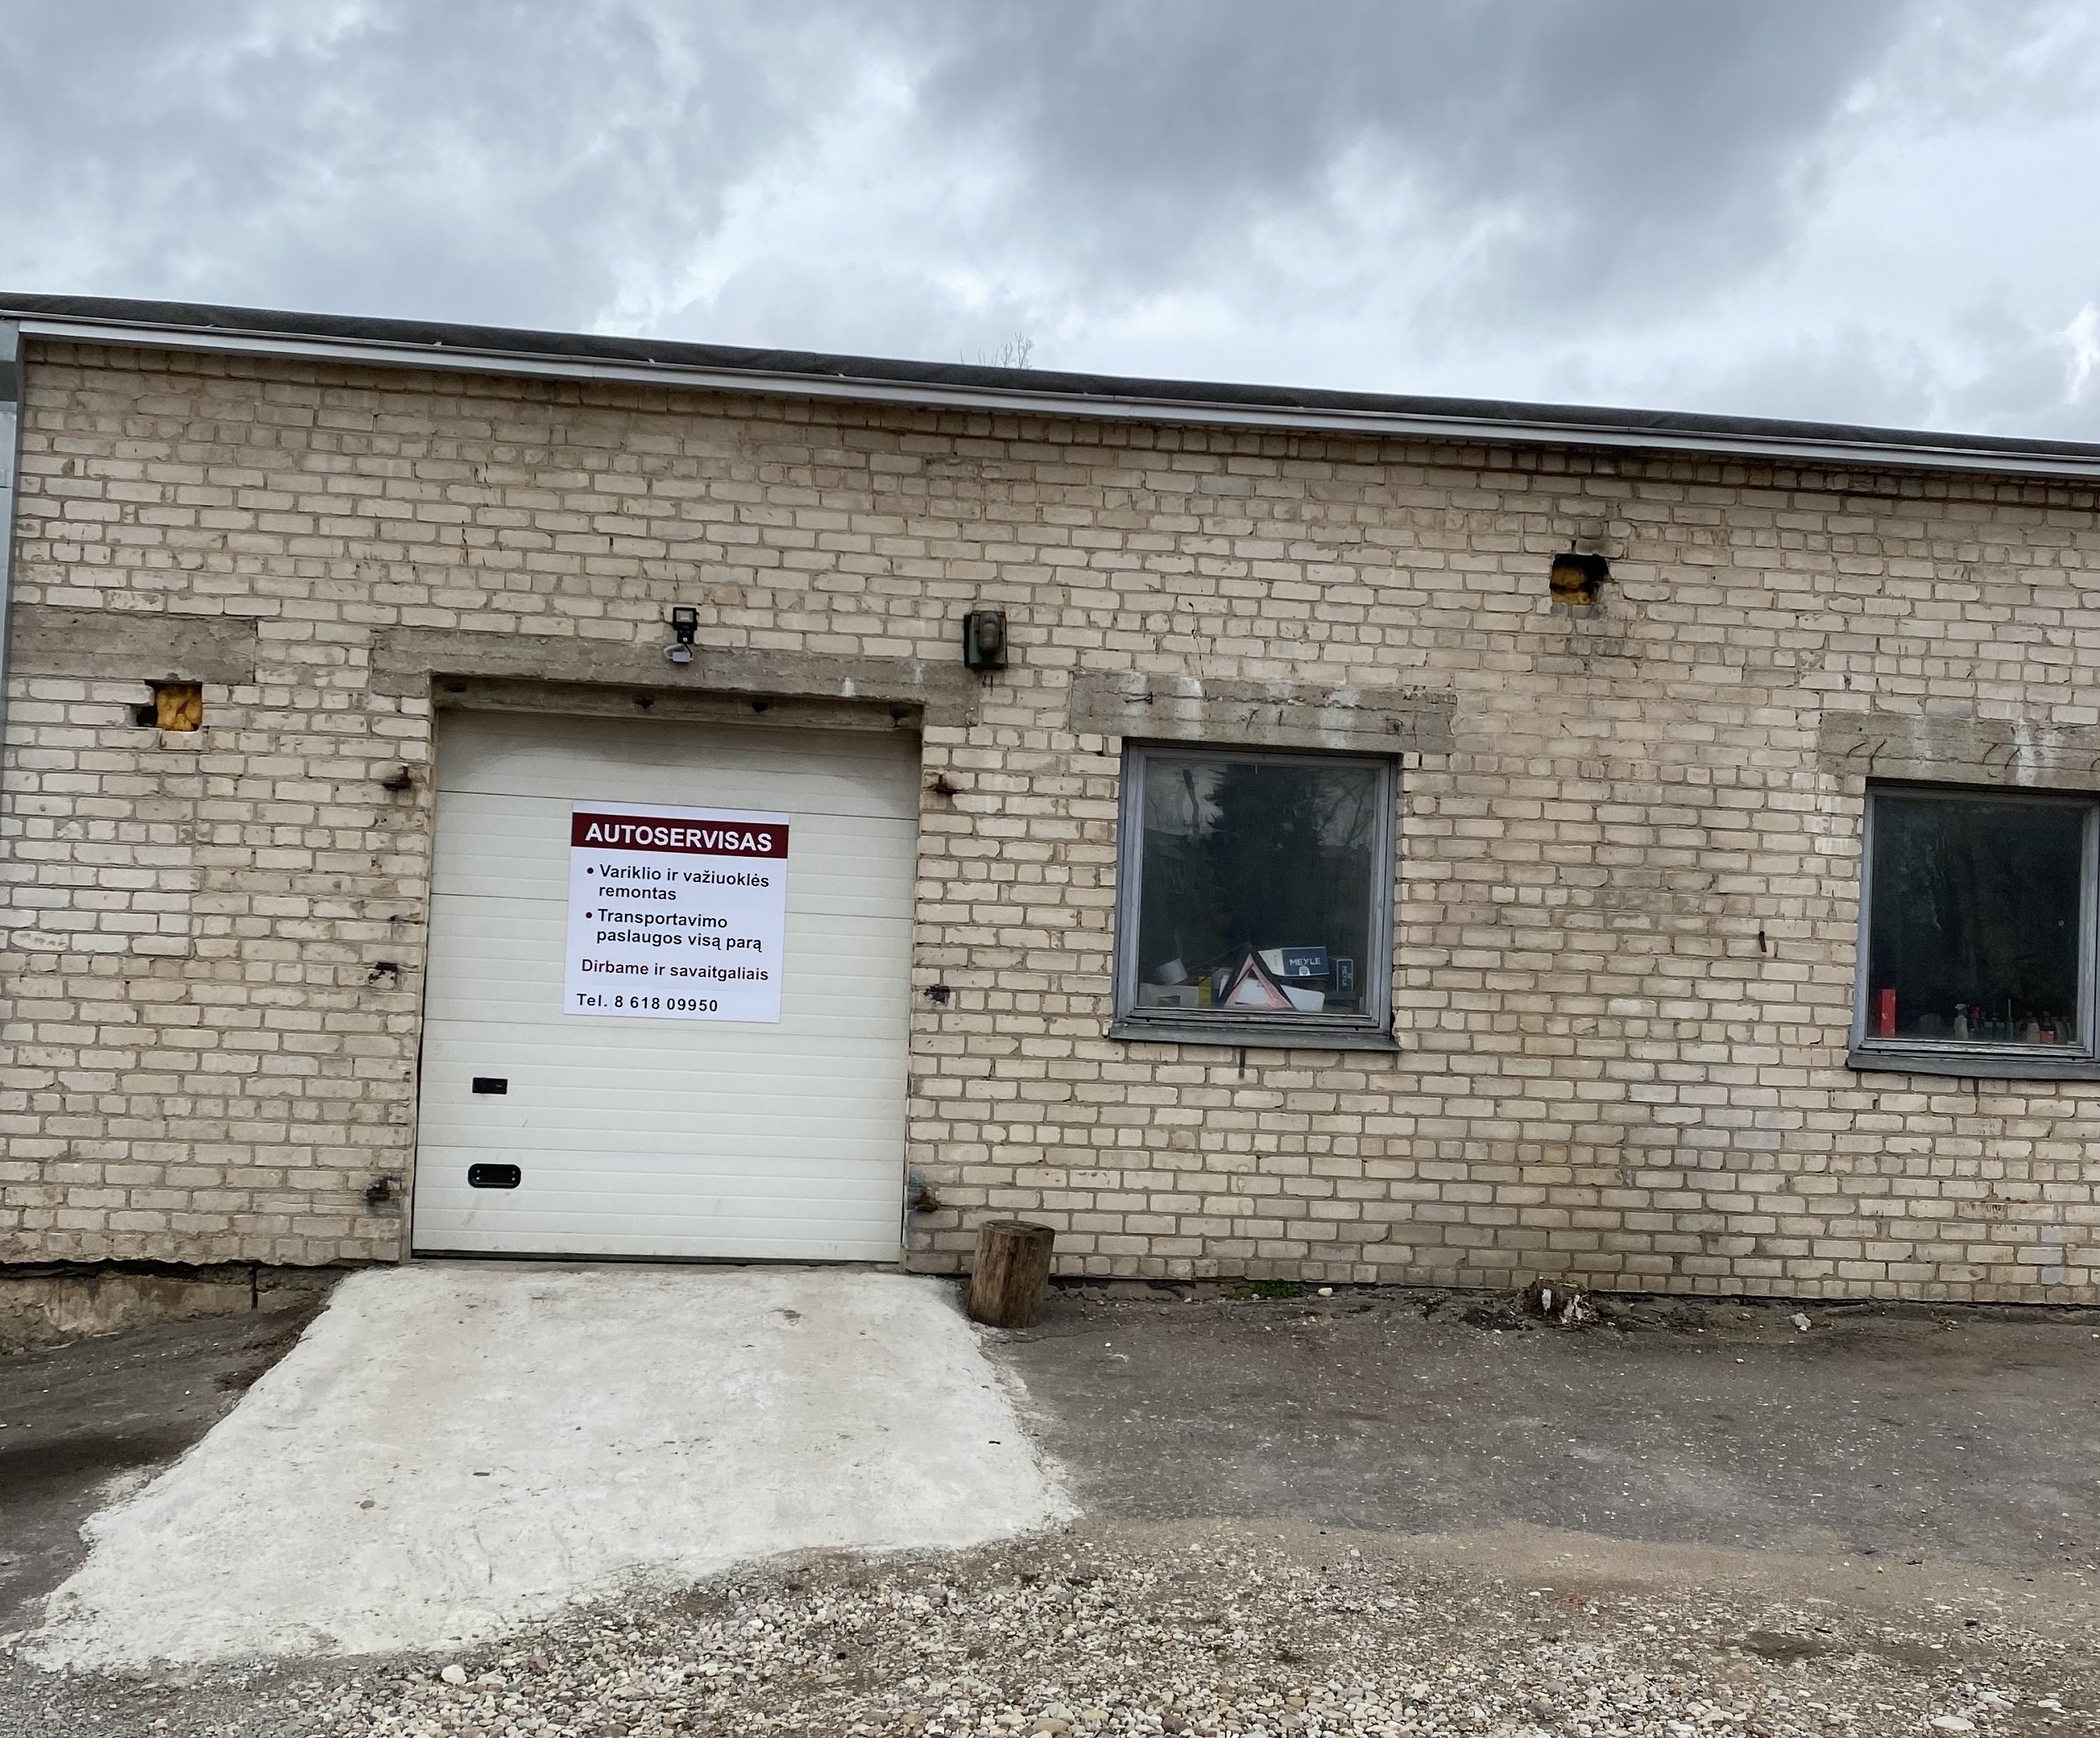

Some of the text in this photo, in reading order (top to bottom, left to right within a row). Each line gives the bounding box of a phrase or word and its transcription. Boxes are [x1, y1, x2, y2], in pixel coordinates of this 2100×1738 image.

[585, 822, 772, 852] AUTOSERVISAS
[599, 864, 769, 887] Variklio ir važiuoklės
[598, 885, 677, 901] remontas
[597, 909, 727, 928] Transportavimo
[596, 929, 763, 953] paslaugos visą parą
[581, 959, 769, 982] Dirbame ir savaitgaliais
[1289, 958, 1321, 966] MEYLE
[576, 993, 718, 1012] Tel. 8 618 09950
